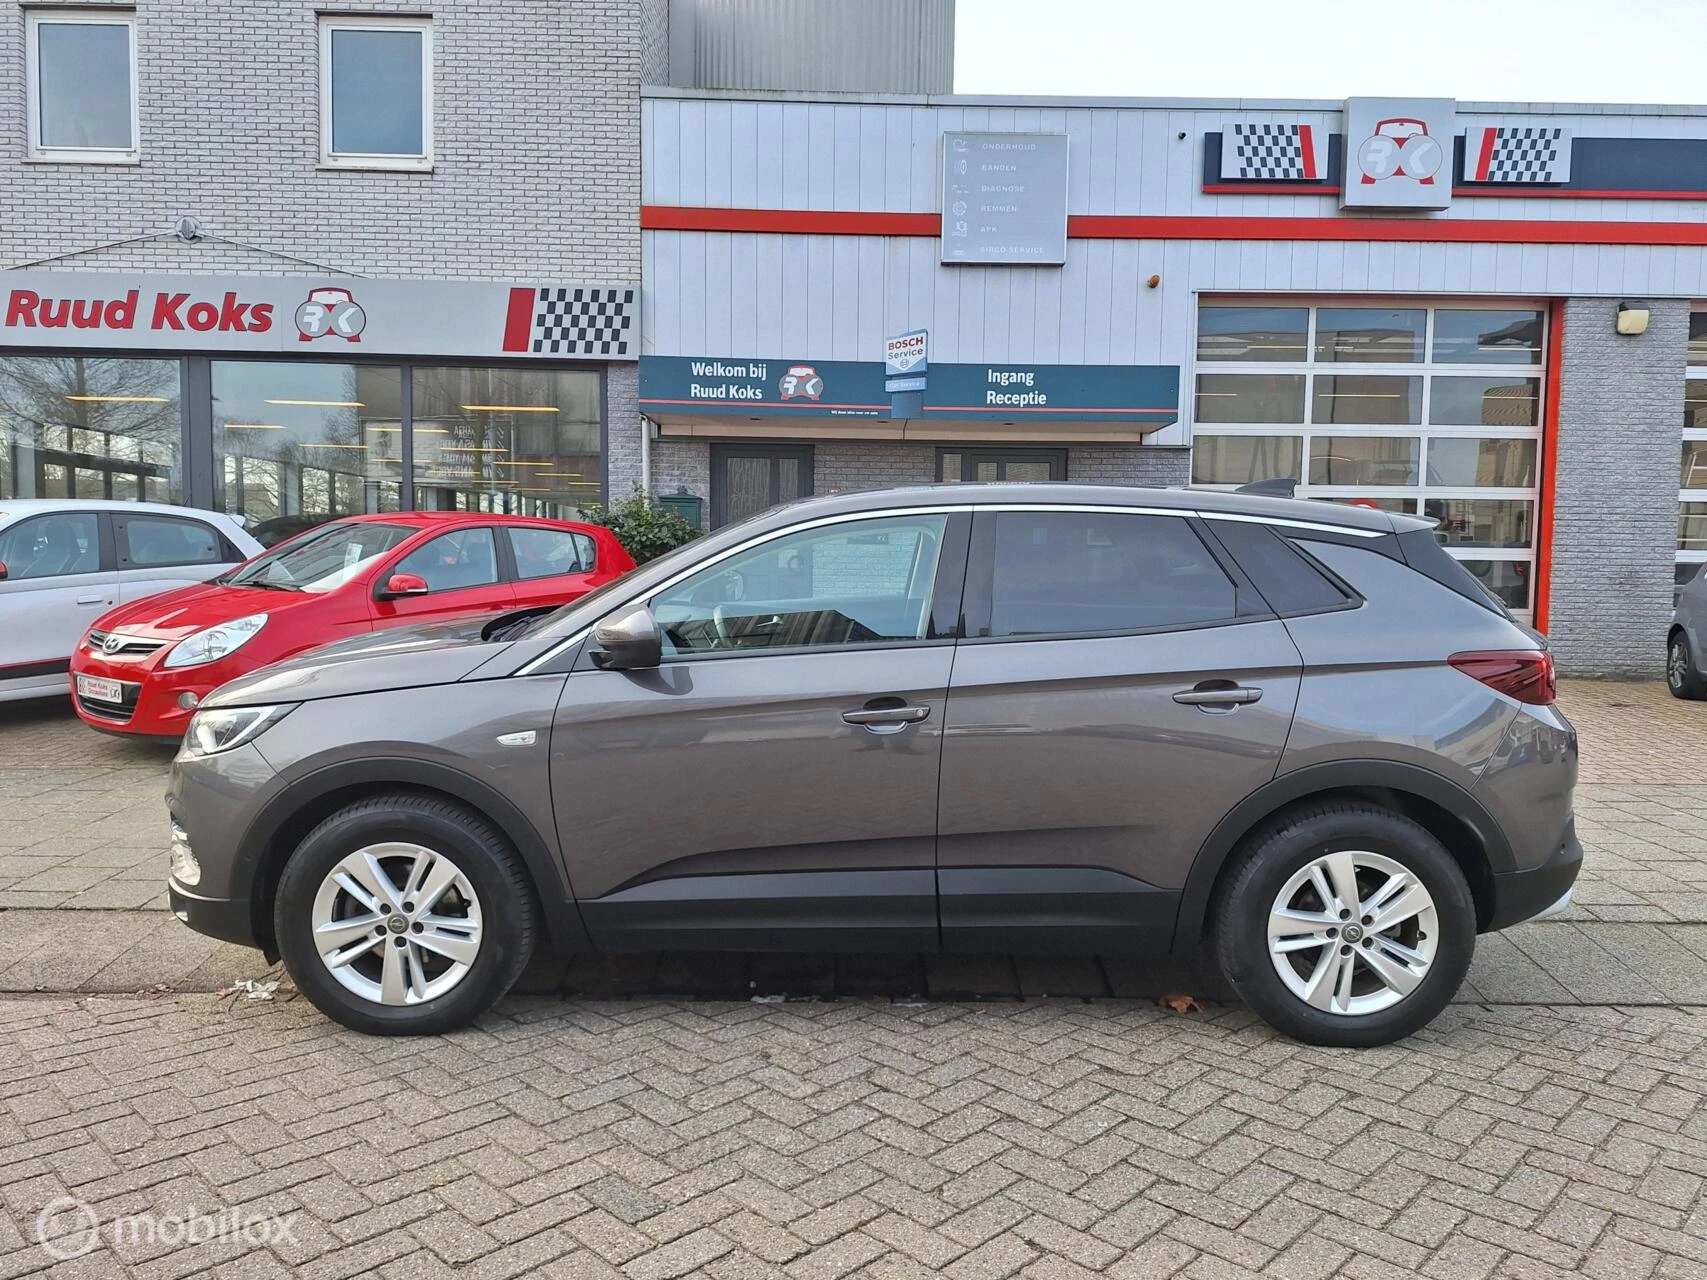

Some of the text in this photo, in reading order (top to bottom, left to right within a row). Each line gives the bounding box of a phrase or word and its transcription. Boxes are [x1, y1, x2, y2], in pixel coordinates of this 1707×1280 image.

[981, 143, 1037, 151] ONDERHOUD
[981, 164, 1017, 172] BANDEN
[981, 185, 1025, 193] DIAGNOSE
[5, 289, 274, 333] Ruud Koks
[888, 336, 924, 351] BOSCH
[888, 348, 924, 360] Service
[691, 361, 767, 381] Welkom bij
[987, 369, 1034, 386] Ingang
[690, 384, 763, 400] Ruud Koks
[986, 391, 1047, 407] Receptie
